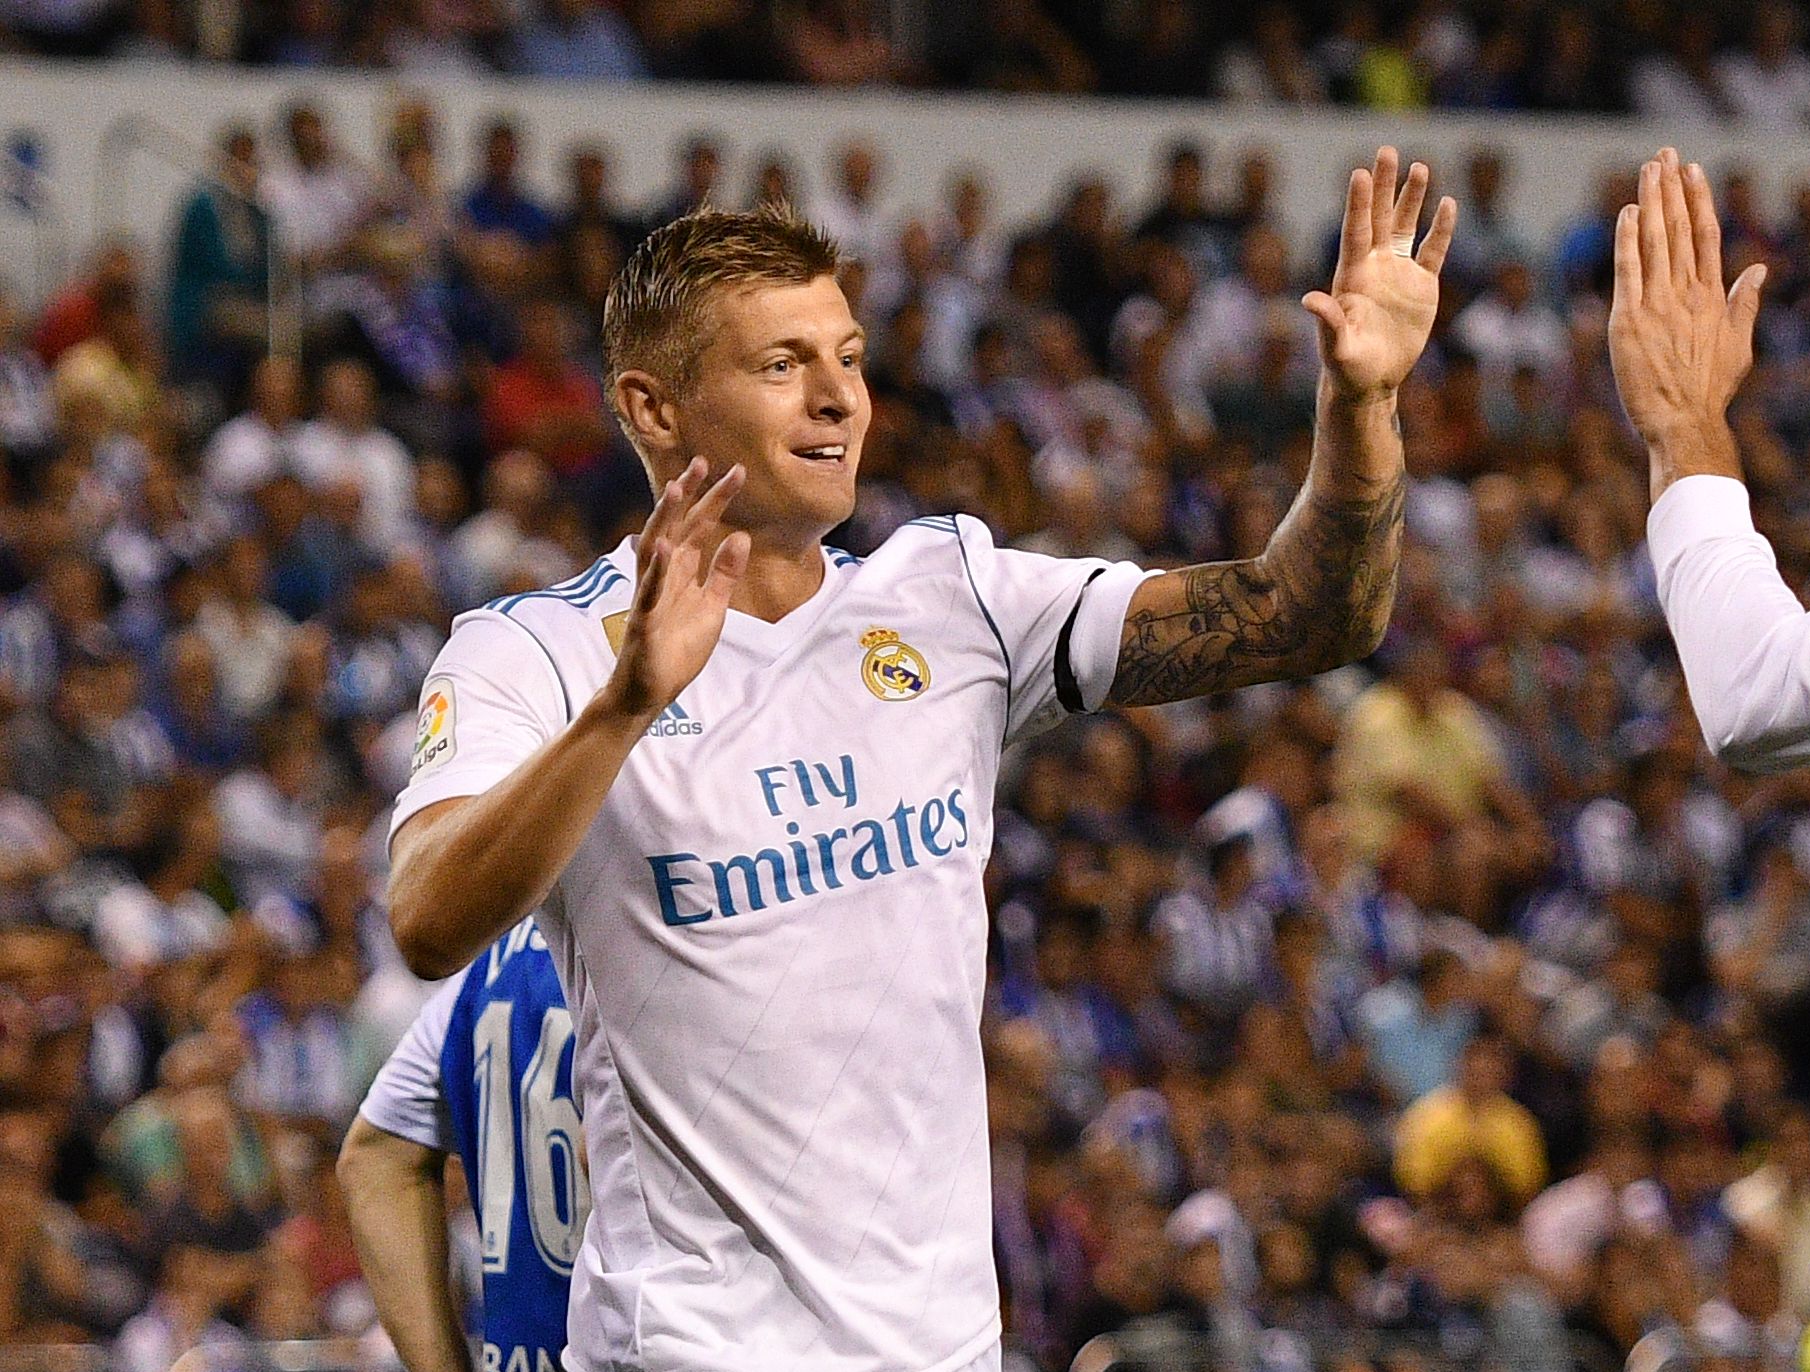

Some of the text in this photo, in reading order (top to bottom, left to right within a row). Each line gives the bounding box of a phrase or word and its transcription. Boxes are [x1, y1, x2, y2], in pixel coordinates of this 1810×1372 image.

[643, 719, 703, 738] didas
[755, 753, 857, 818] Fly
[646, 785, 969, 927] Emirates
[473, 1000, 592, 1277] 16
